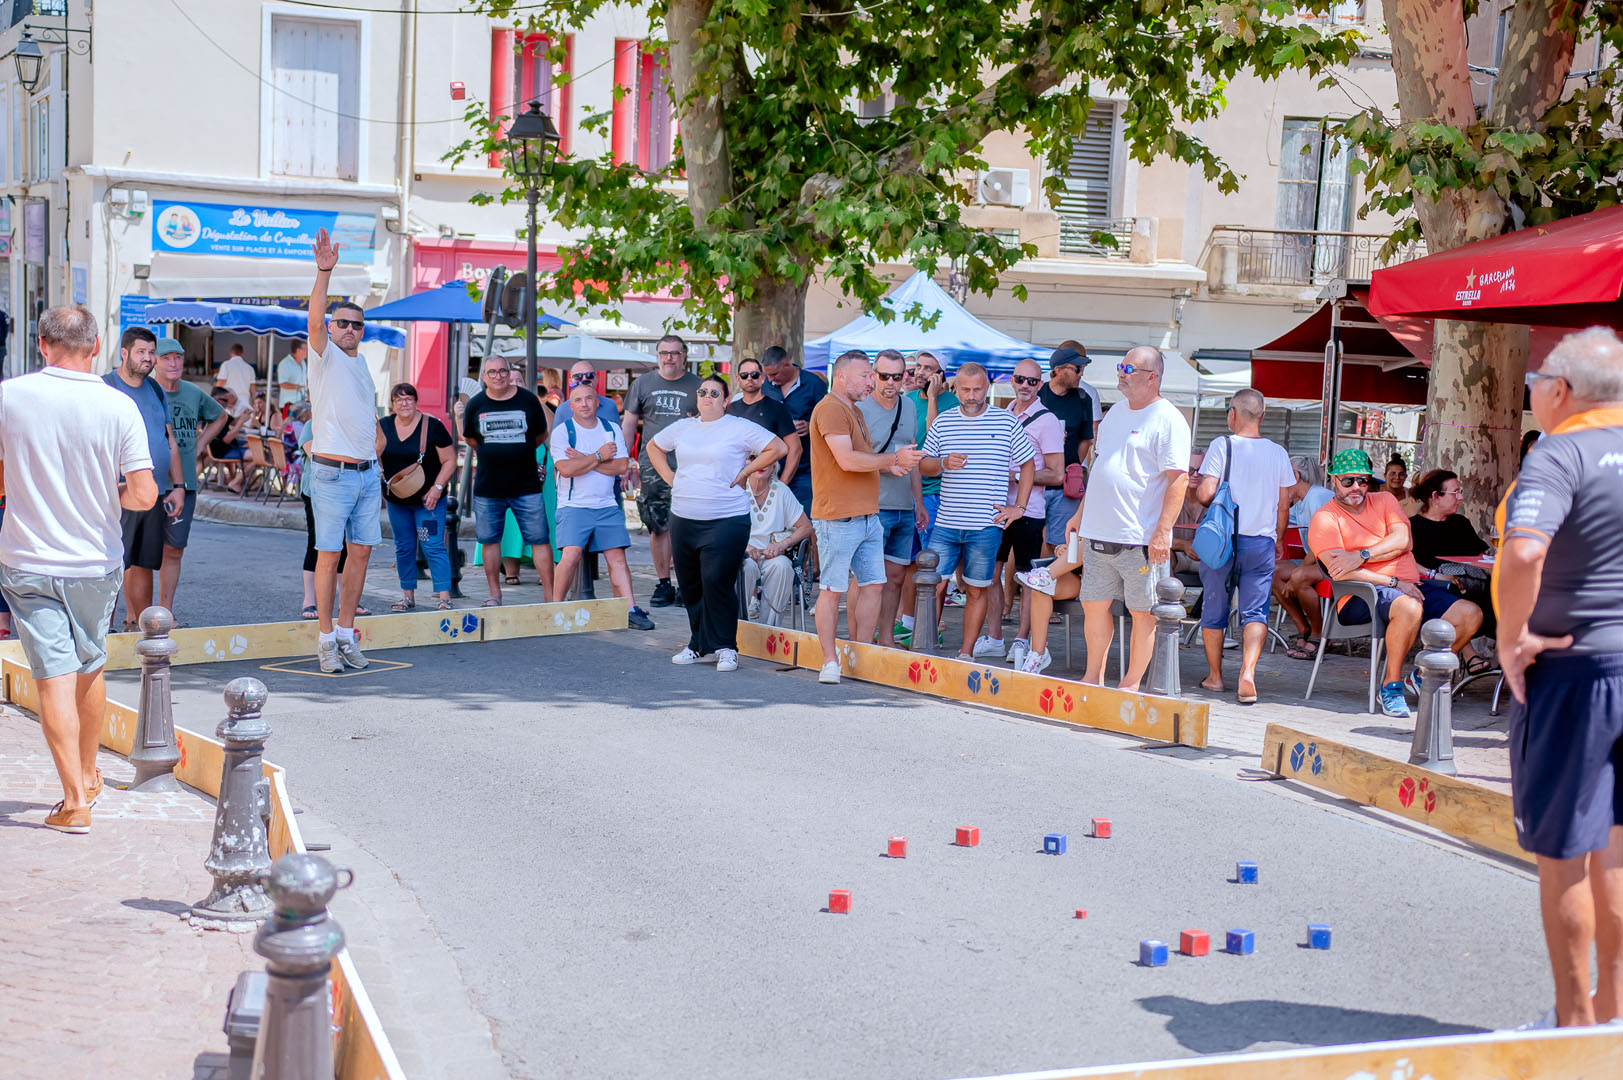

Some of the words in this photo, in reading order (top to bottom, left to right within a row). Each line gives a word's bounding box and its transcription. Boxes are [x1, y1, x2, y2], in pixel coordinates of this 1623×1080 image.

[202, 227, 257, 241] Dégustation
[260, 231, 272, 242] de
[210, 244, 230, 252] VENTE
[246, 246, 266, 254] PLACE
[1480, 266, 1515, 286] BARCELONA
[1455, 290, 1481, 301] ESTRELLA
[1321, 363, 1331, 462] ESPETO
[171, 417, 198, 430] LAND
